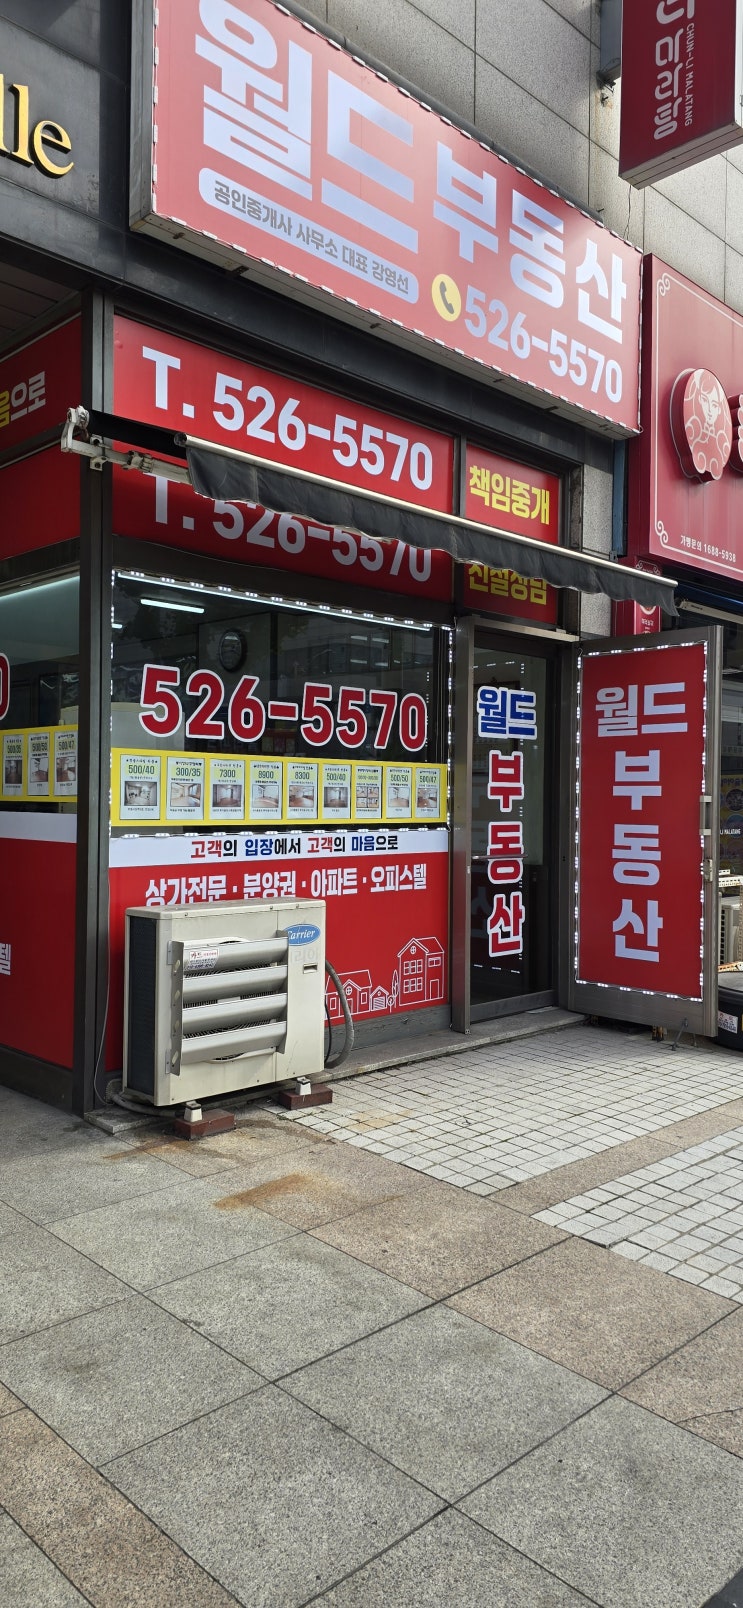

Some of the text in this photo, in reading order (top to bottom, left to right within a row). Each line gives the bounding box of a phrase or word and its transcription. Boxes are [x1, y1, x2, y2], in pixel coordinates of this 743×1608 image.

[684, 22, 695, 127] CHUN-LI MALATANG
[196, 0, 627, 345] 월드 부동산
[214, 180, 409, 295] 공인중개사 사무소 대표 강영선
[464, 285, 623, 403] 526-5570
[142, 346, 433, 491] T. 526-5570
[469, 465, 550, 525] 책임중개
[680, 534, 702, 552] 가맹문의
[138, 664, 428, 752] 526-5570
[128, 764, 155, 775] 500/40
[175, 767, 201, 777] 300/35
[219, 769, 236, 778] 7300
[190, 835, 399, 859] 고객의 입장에서 고객의 마음으로
[477, 685, 537, 958] 월드 부동산
[595, 682, 689, 963] 월드 부동산
[145, 863, 427, 907] 상가전문 분양권 아파트 오피스텔
